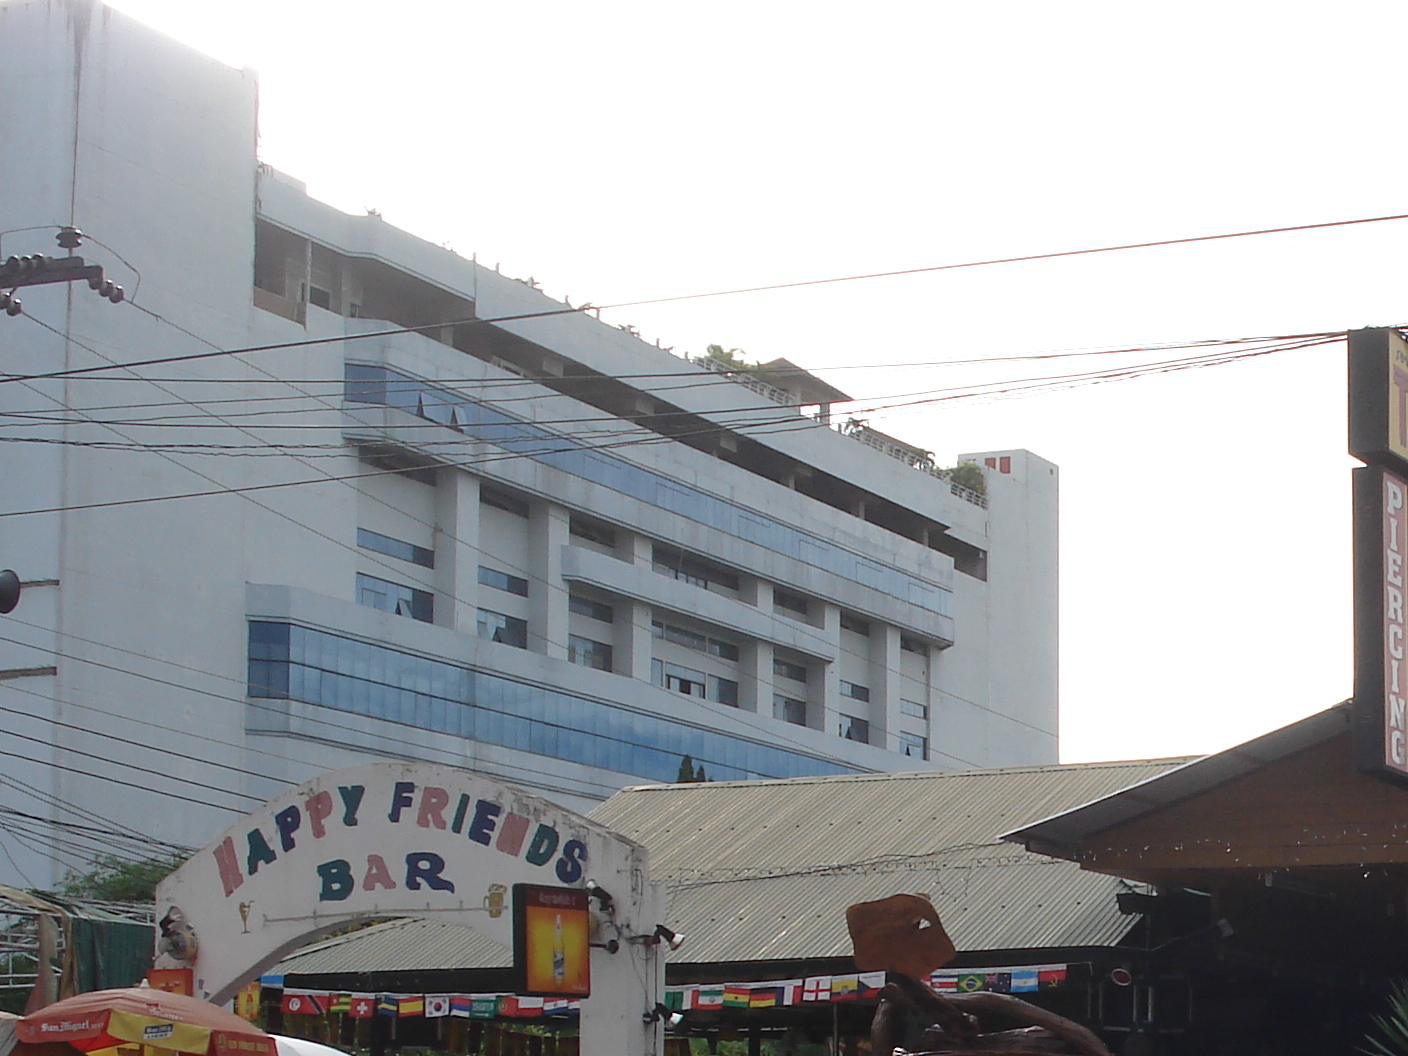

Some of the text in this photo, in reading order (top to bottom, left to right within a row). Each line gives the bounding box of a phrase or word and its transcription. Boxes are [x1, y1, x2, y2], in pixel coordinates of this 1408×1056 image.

[1386, 480, 1405, 765] PIERCING
[213, 782, 588, 897] HAPPY FRIENDS
[317, 852, 455, 902] BAR
